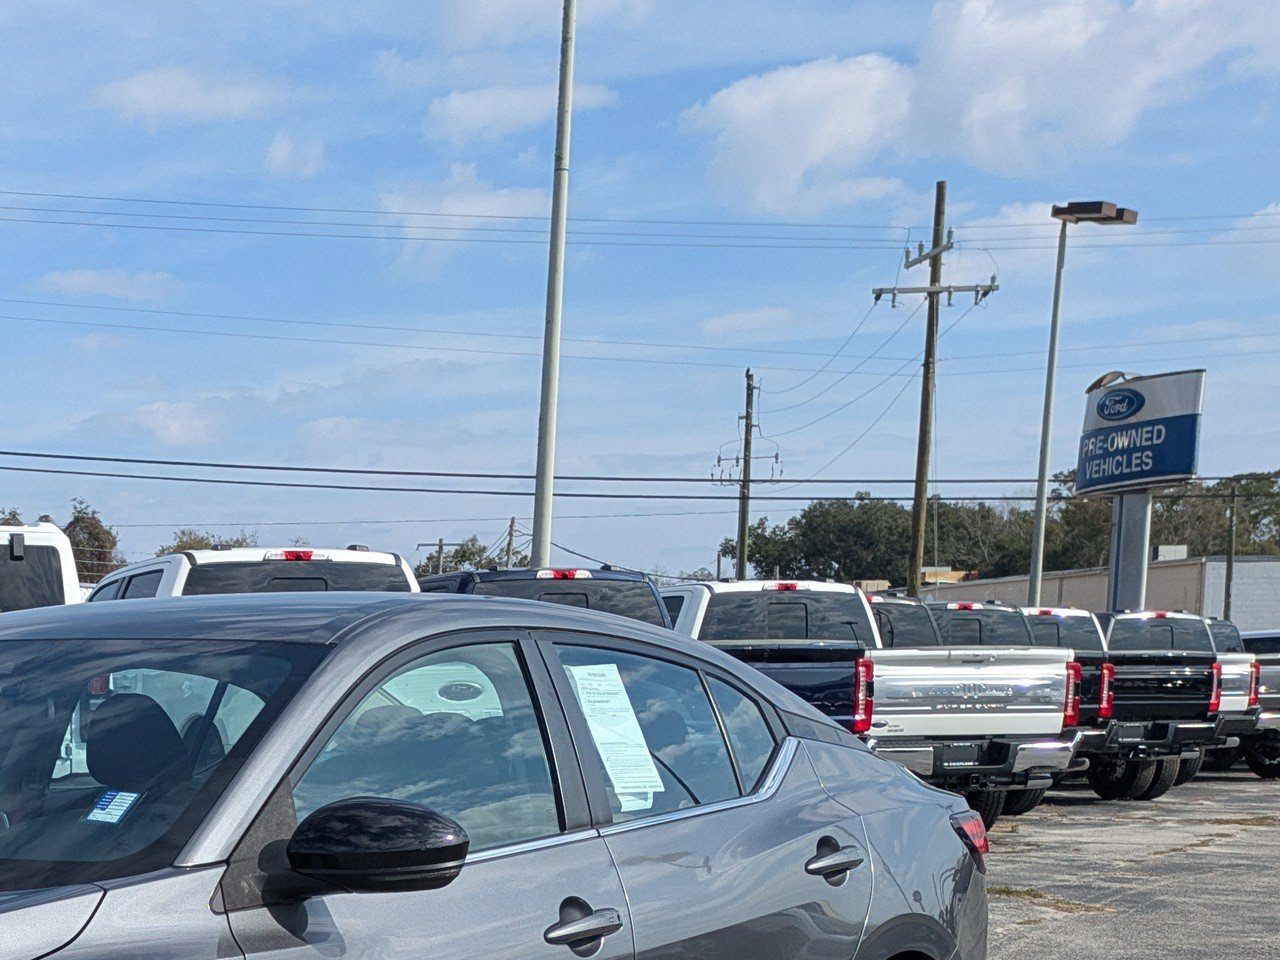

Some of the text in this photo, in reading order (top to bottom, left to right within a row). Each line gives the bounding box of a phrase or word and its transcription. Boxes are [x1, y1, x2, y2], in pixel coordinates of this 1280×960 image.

[1103, 395, 1128, 414] Ford
[1082, 424, 1166, 458] PRE-OWNED
[1085, 450, 1153, 480] VEHICLES
